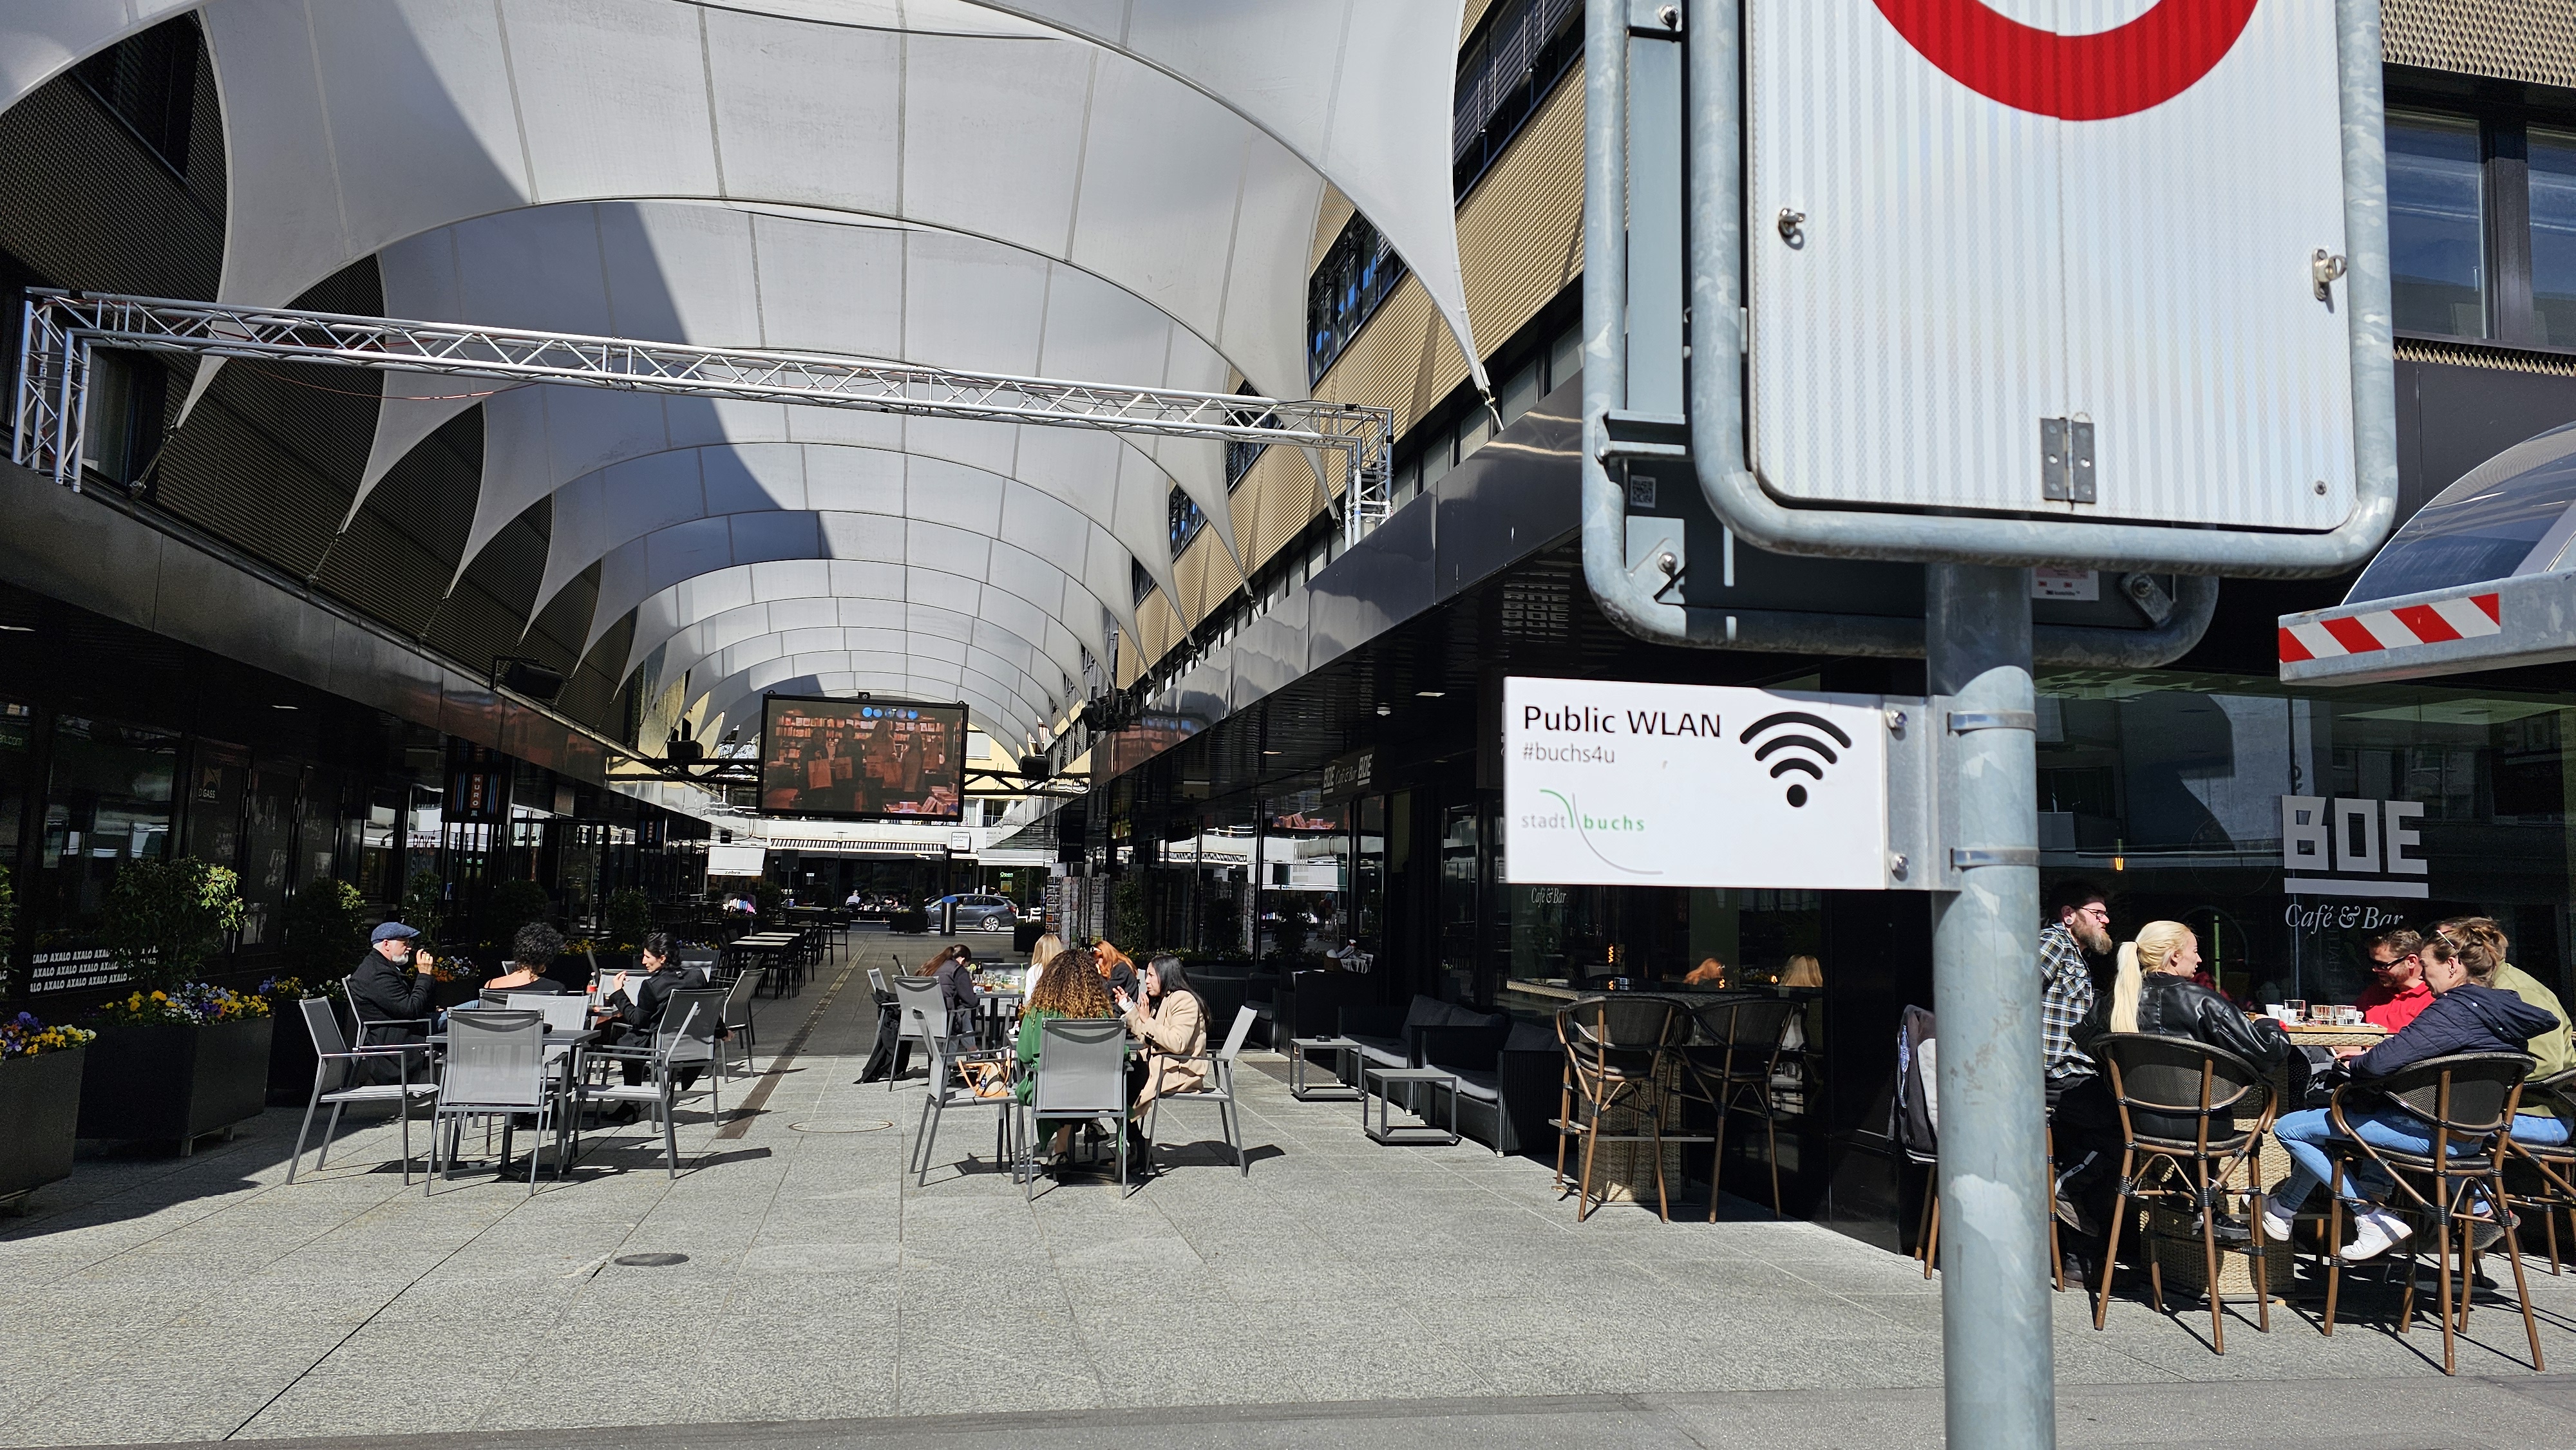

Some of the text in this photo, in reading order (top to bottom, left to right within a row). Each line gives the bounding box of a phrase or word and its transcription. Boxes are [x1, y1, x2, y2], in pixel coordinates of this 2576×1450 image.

[1524, 704, 1721, 738] Public WLAN
[1522, 741, 1616, 764] #buchs4u
[1323, 766, 1336, 788] BOE
[1358, 754, 1373, 779] BOE
[472, 776, 480, 806] KURO
[1520, 813, 1645, 831] stadt buchs
[2282, 795, 2428, 874] BOE
[1531, 887, 1566, 908] Café & Bar
[2285, 903, 2333, 934] Café
[2338, 905, 2361, 928] &
[50, 951, 71, 963] AXALO
[72, 950, 93, 961] AXALO
[32, 967, 55, 978] AXALO
[56, 965, 77, 975] AXALO
[79, 963, 98, 974] AXALO
[43, 980, 65, 990] AXALO
[66, 978, 87, 988] AXALO
[88, 975, 108, 986] AXALO
[108, 973, 128, 983] AXALO
